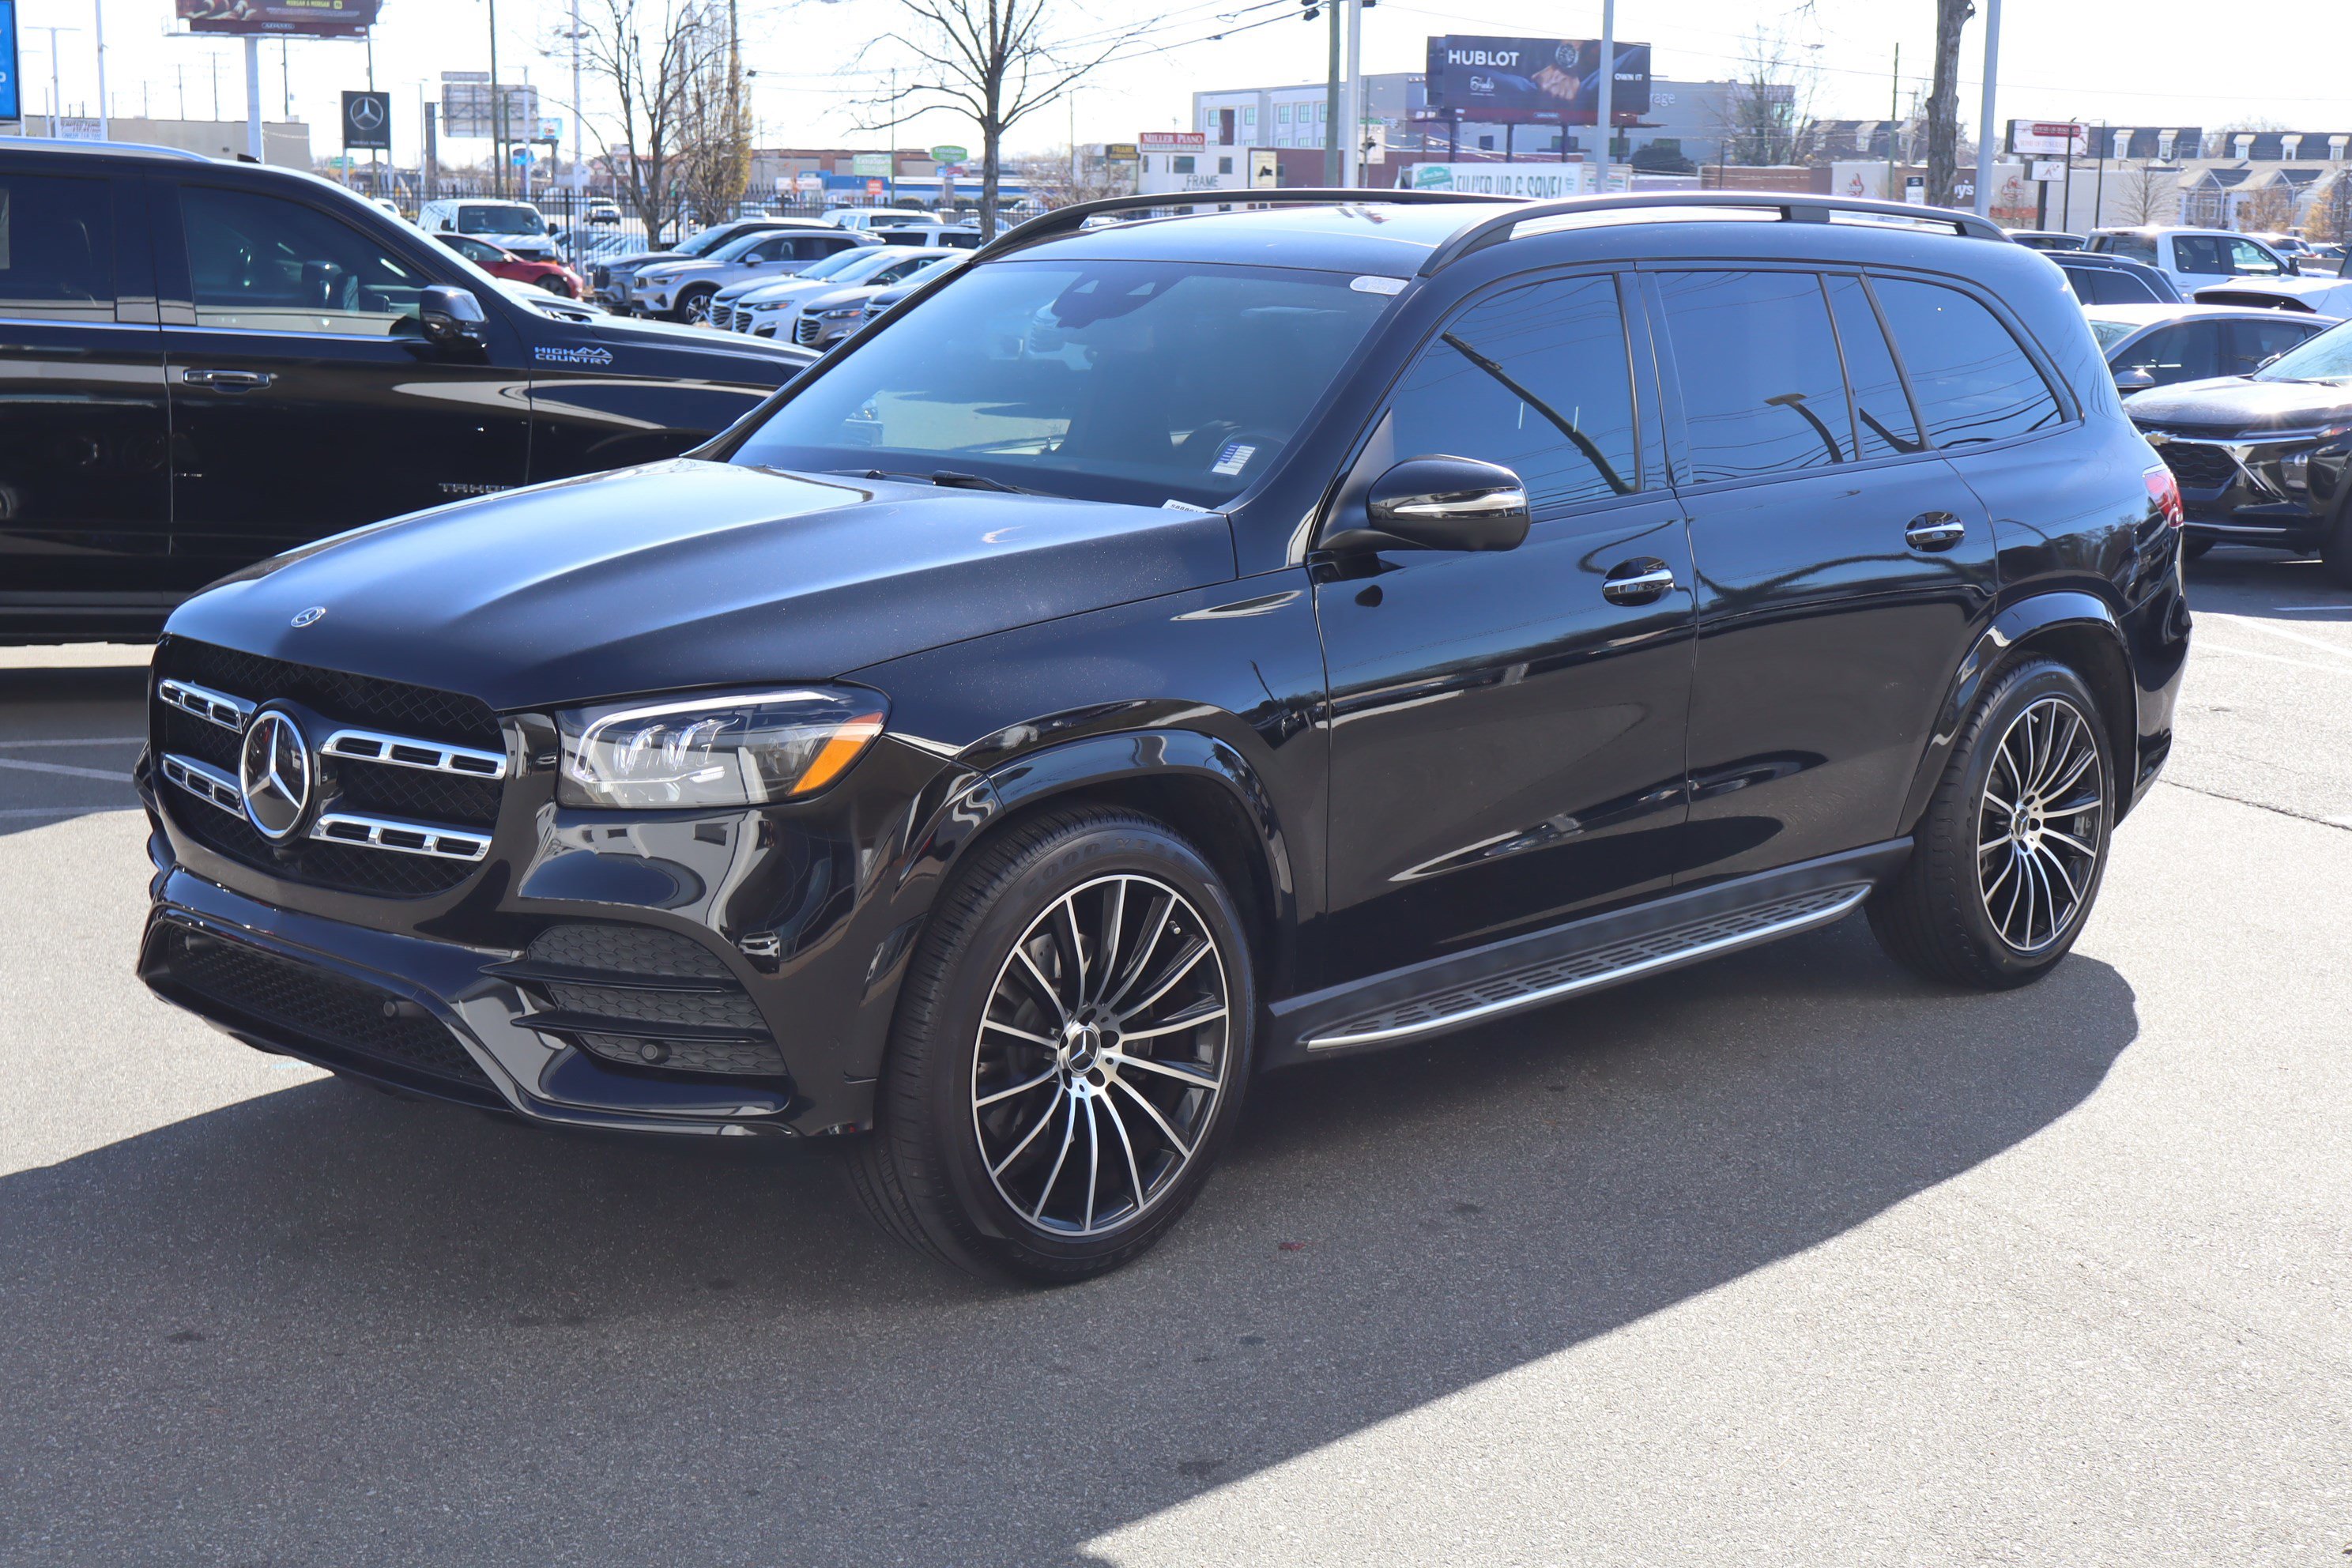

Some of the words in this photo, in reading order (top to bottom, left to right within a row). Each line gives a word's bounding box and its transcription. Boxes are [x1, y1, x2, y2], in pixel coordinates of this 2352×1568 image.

[1448, 50, 1520, 66] HUBLOT
[1144, 134, 1174, 143] MILLER
[1178, 135, 1203, 144] PIANO
[1186, 175, 1219, 187] FRAME
[534, 346, 575, 355] HIGH
[535, 353, 613, 365] COUNTRY
